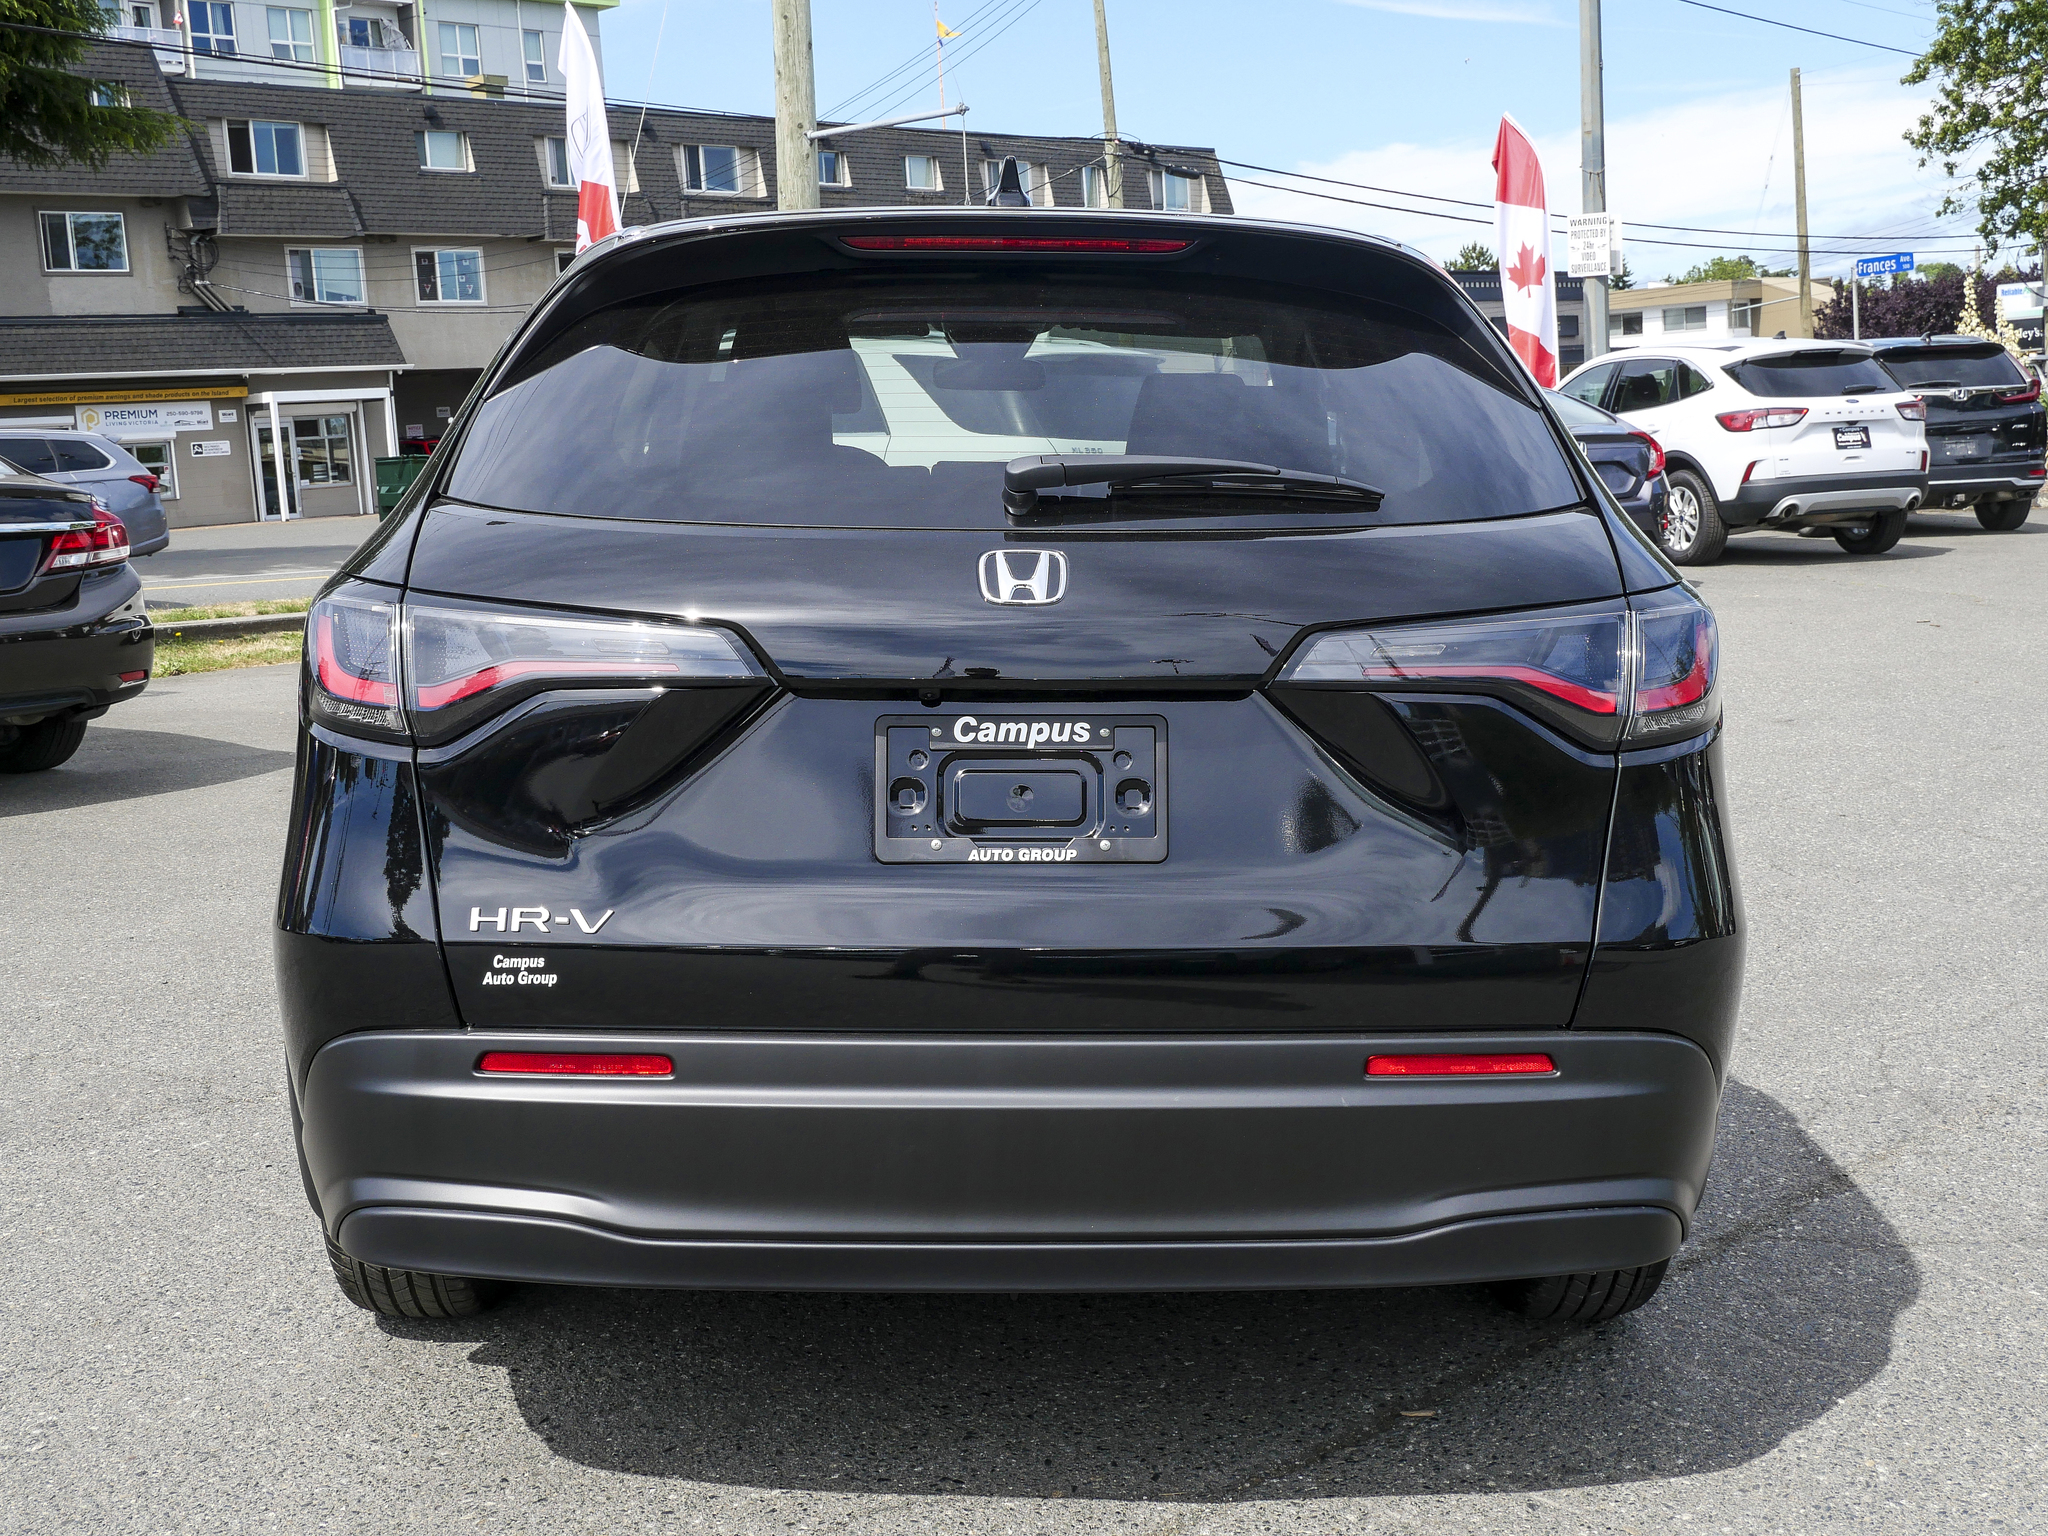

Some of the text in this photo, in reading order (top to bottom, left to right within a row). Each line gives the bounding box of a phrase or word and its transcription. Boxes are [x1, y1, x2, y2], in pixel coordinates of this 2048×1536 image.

[1570, 217, 1607, 227] WARNING
[1571, 228, 1607, 240] PROTECTED BY
[1582, 252, 1596, 261] VIDEO
[1571, 262, 1607, 274] SURVEILLANCE
[1858, 259, 1897, 274] Frances
[2001, 288, 2023, 296] Reliable
[13, 396, 38, 404] Largest
[39, 395, 68, 403] selection
[77, 394, 104, 402] premium
[145, 391, 163, 399] shade
[164, 391, 191, 399] products
[104, 409, 158, 420] PREMIUM
[953, 716, 1091, 749] Campus
[968, 848, 1078, 862] AUTO GROUP
[469, 906, 615, 935] HR-V
[493, 954, 545, 971] Campus
[482, 971, 558, 987] Auto Group
